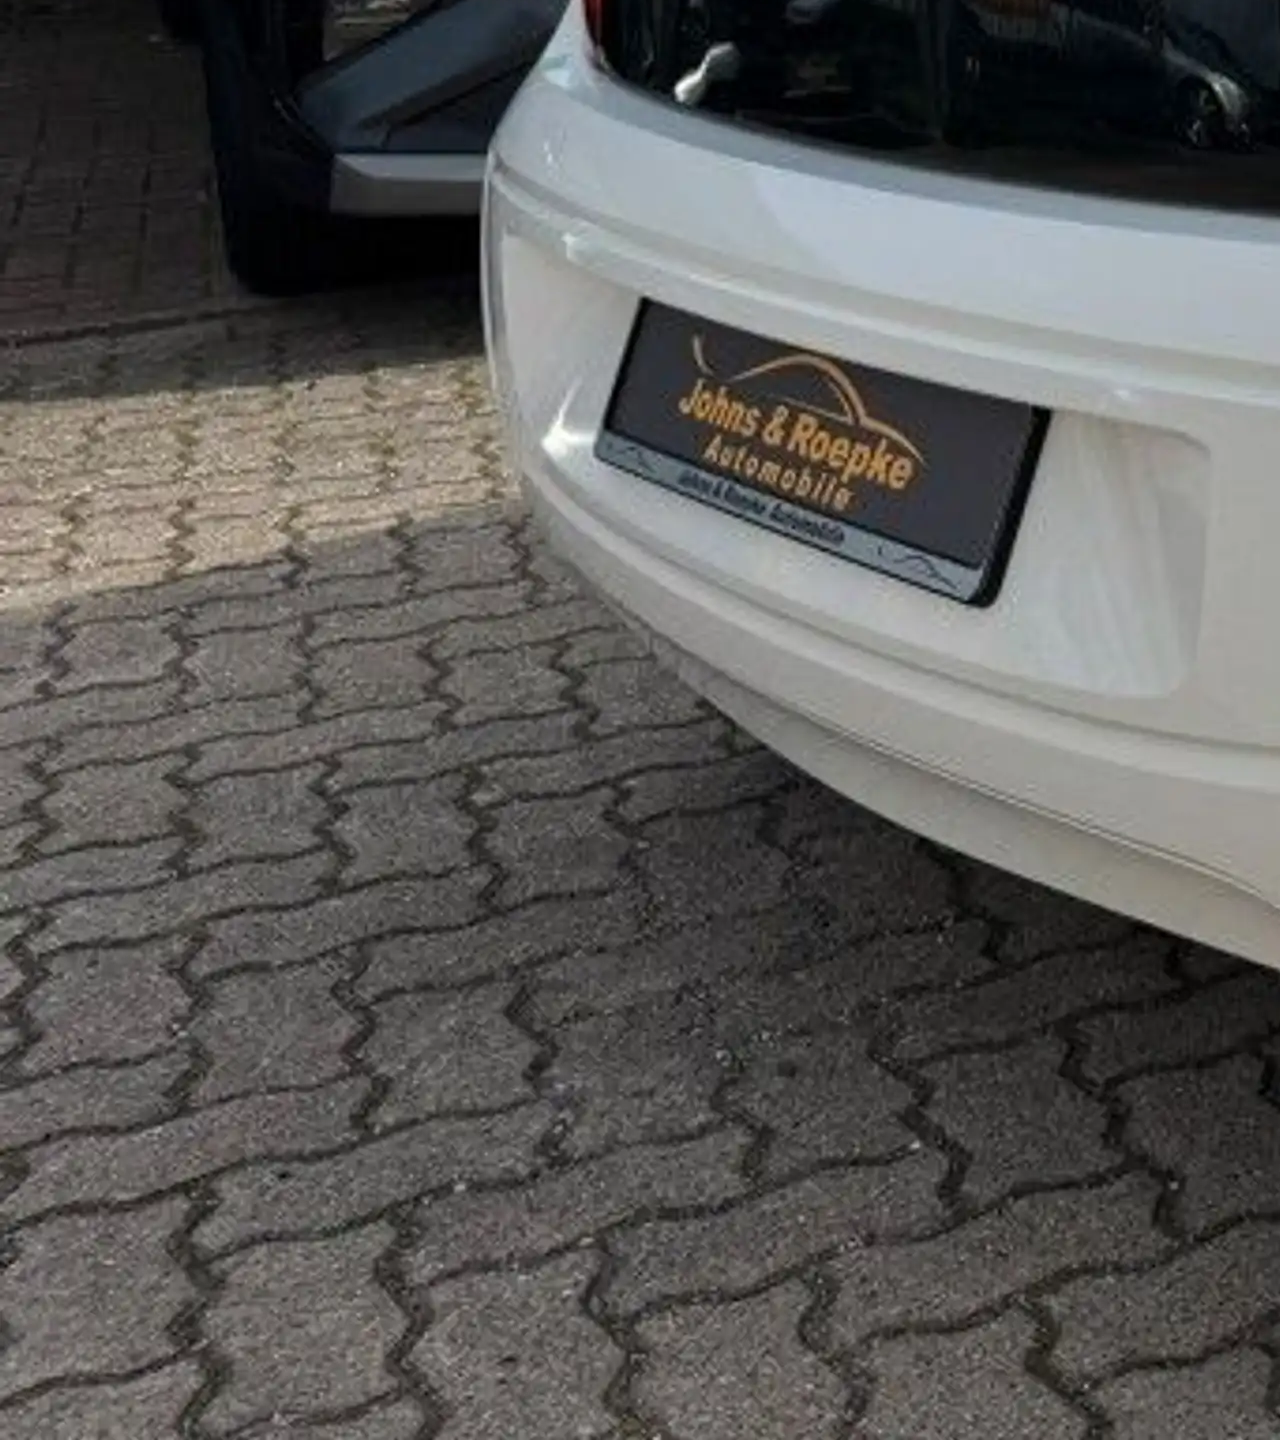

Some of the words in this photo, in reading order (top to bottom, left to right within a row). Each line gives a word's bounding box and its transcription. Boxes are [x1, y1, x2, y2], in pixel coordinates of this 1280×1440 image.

[678, 377, 761, 437] Johns
[762, 405, 790, 446] &
[786, 412, 914, 491] Roepke
[702, 433, 855, 511] Automobile
